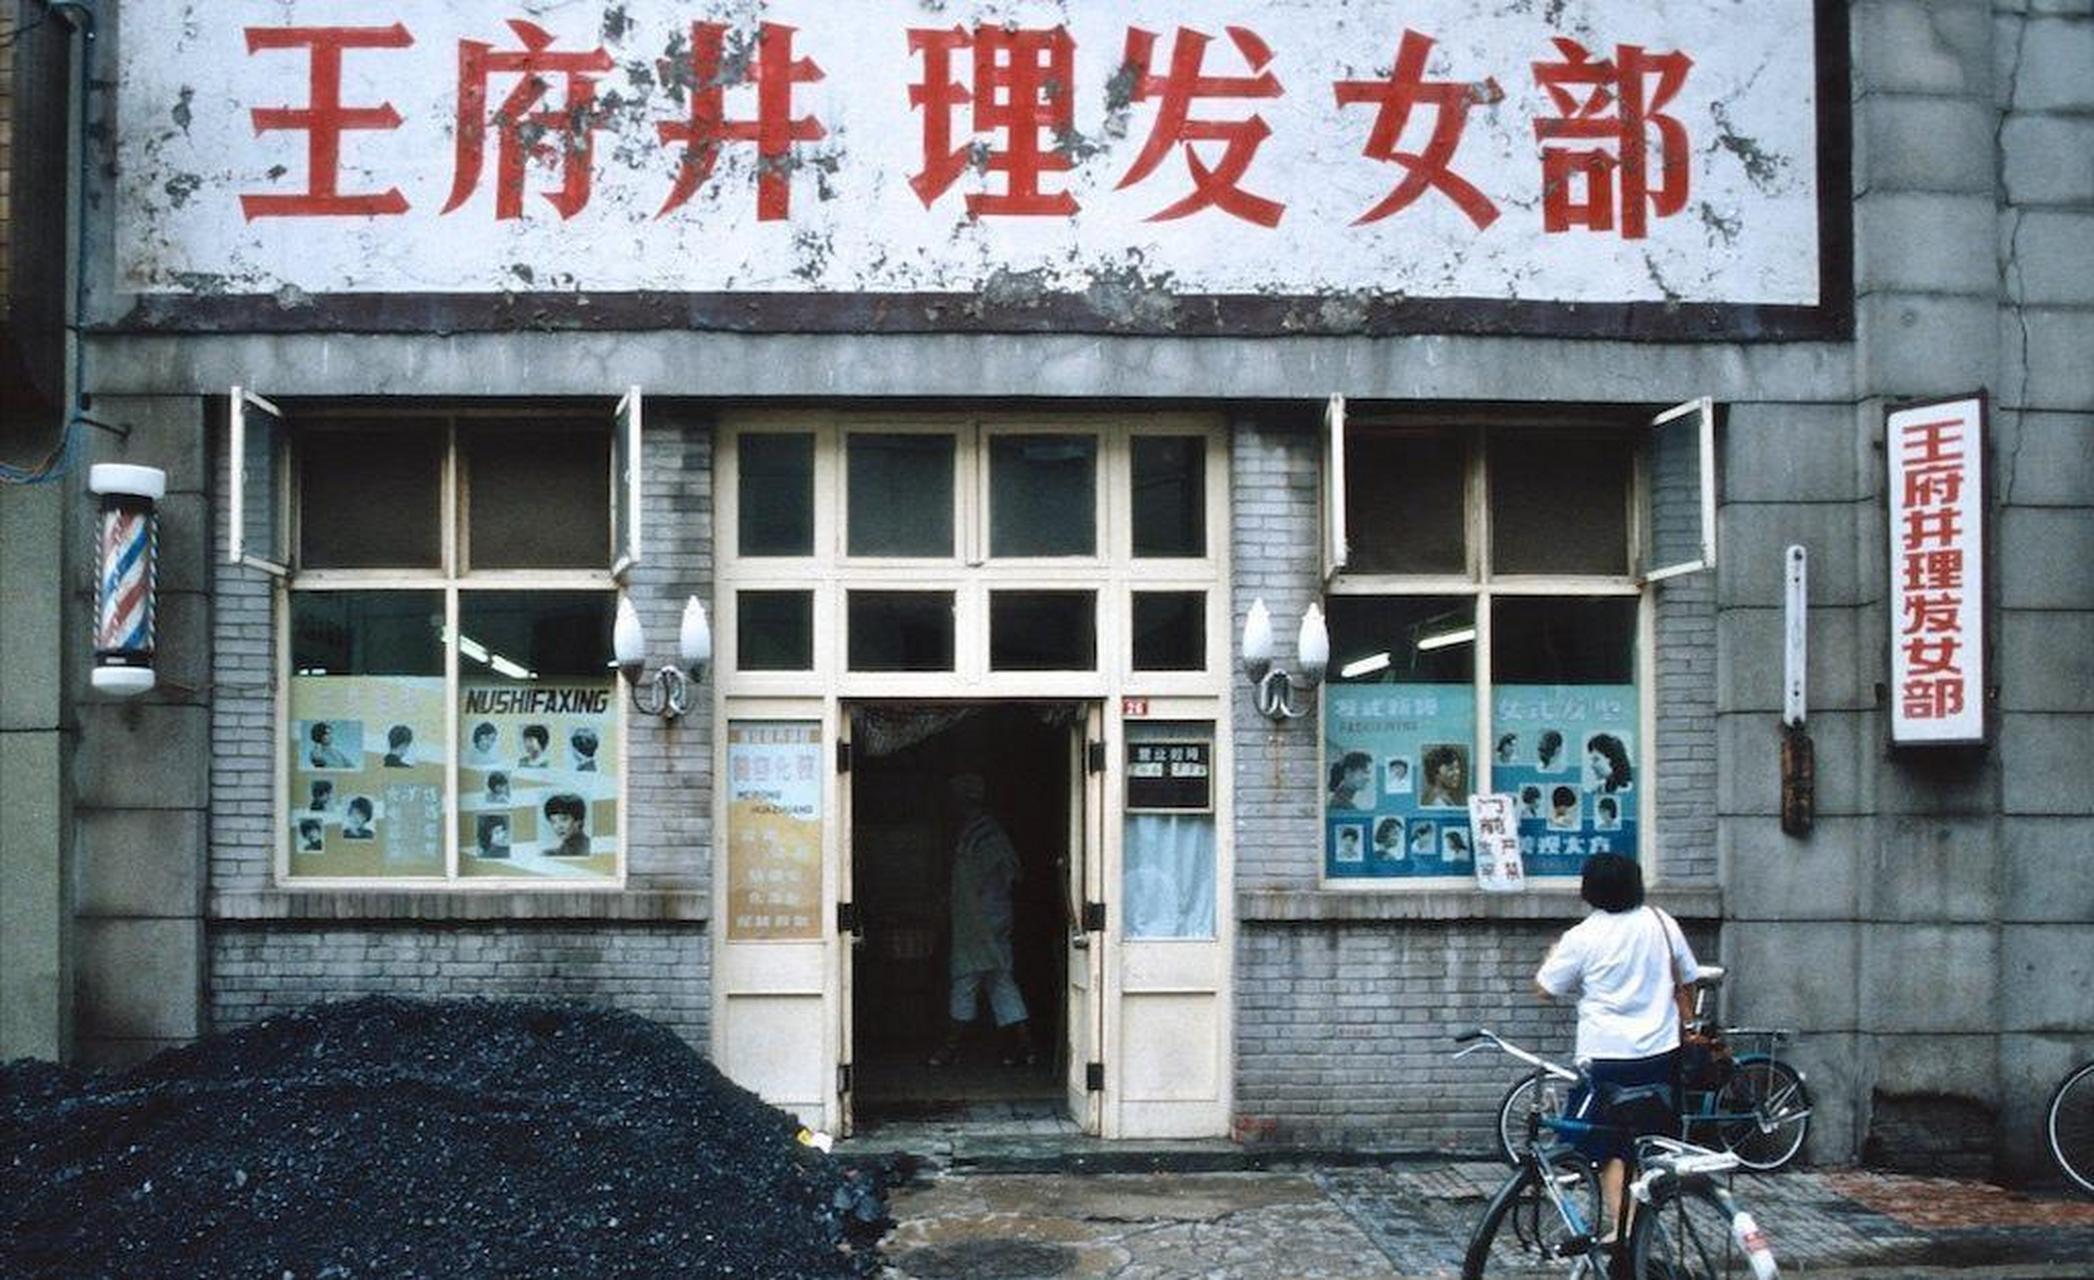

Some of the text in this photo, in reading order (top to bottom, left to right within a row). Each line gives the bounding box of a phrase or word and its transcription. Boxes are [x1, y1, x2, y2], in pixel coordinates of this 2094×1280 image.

[240, 19, 1694, 239] 王府井理发女部
[1902, 419, 1965, 720] 王府井理发女部
[465, 688, 610, 715] NUSHIFAXING
